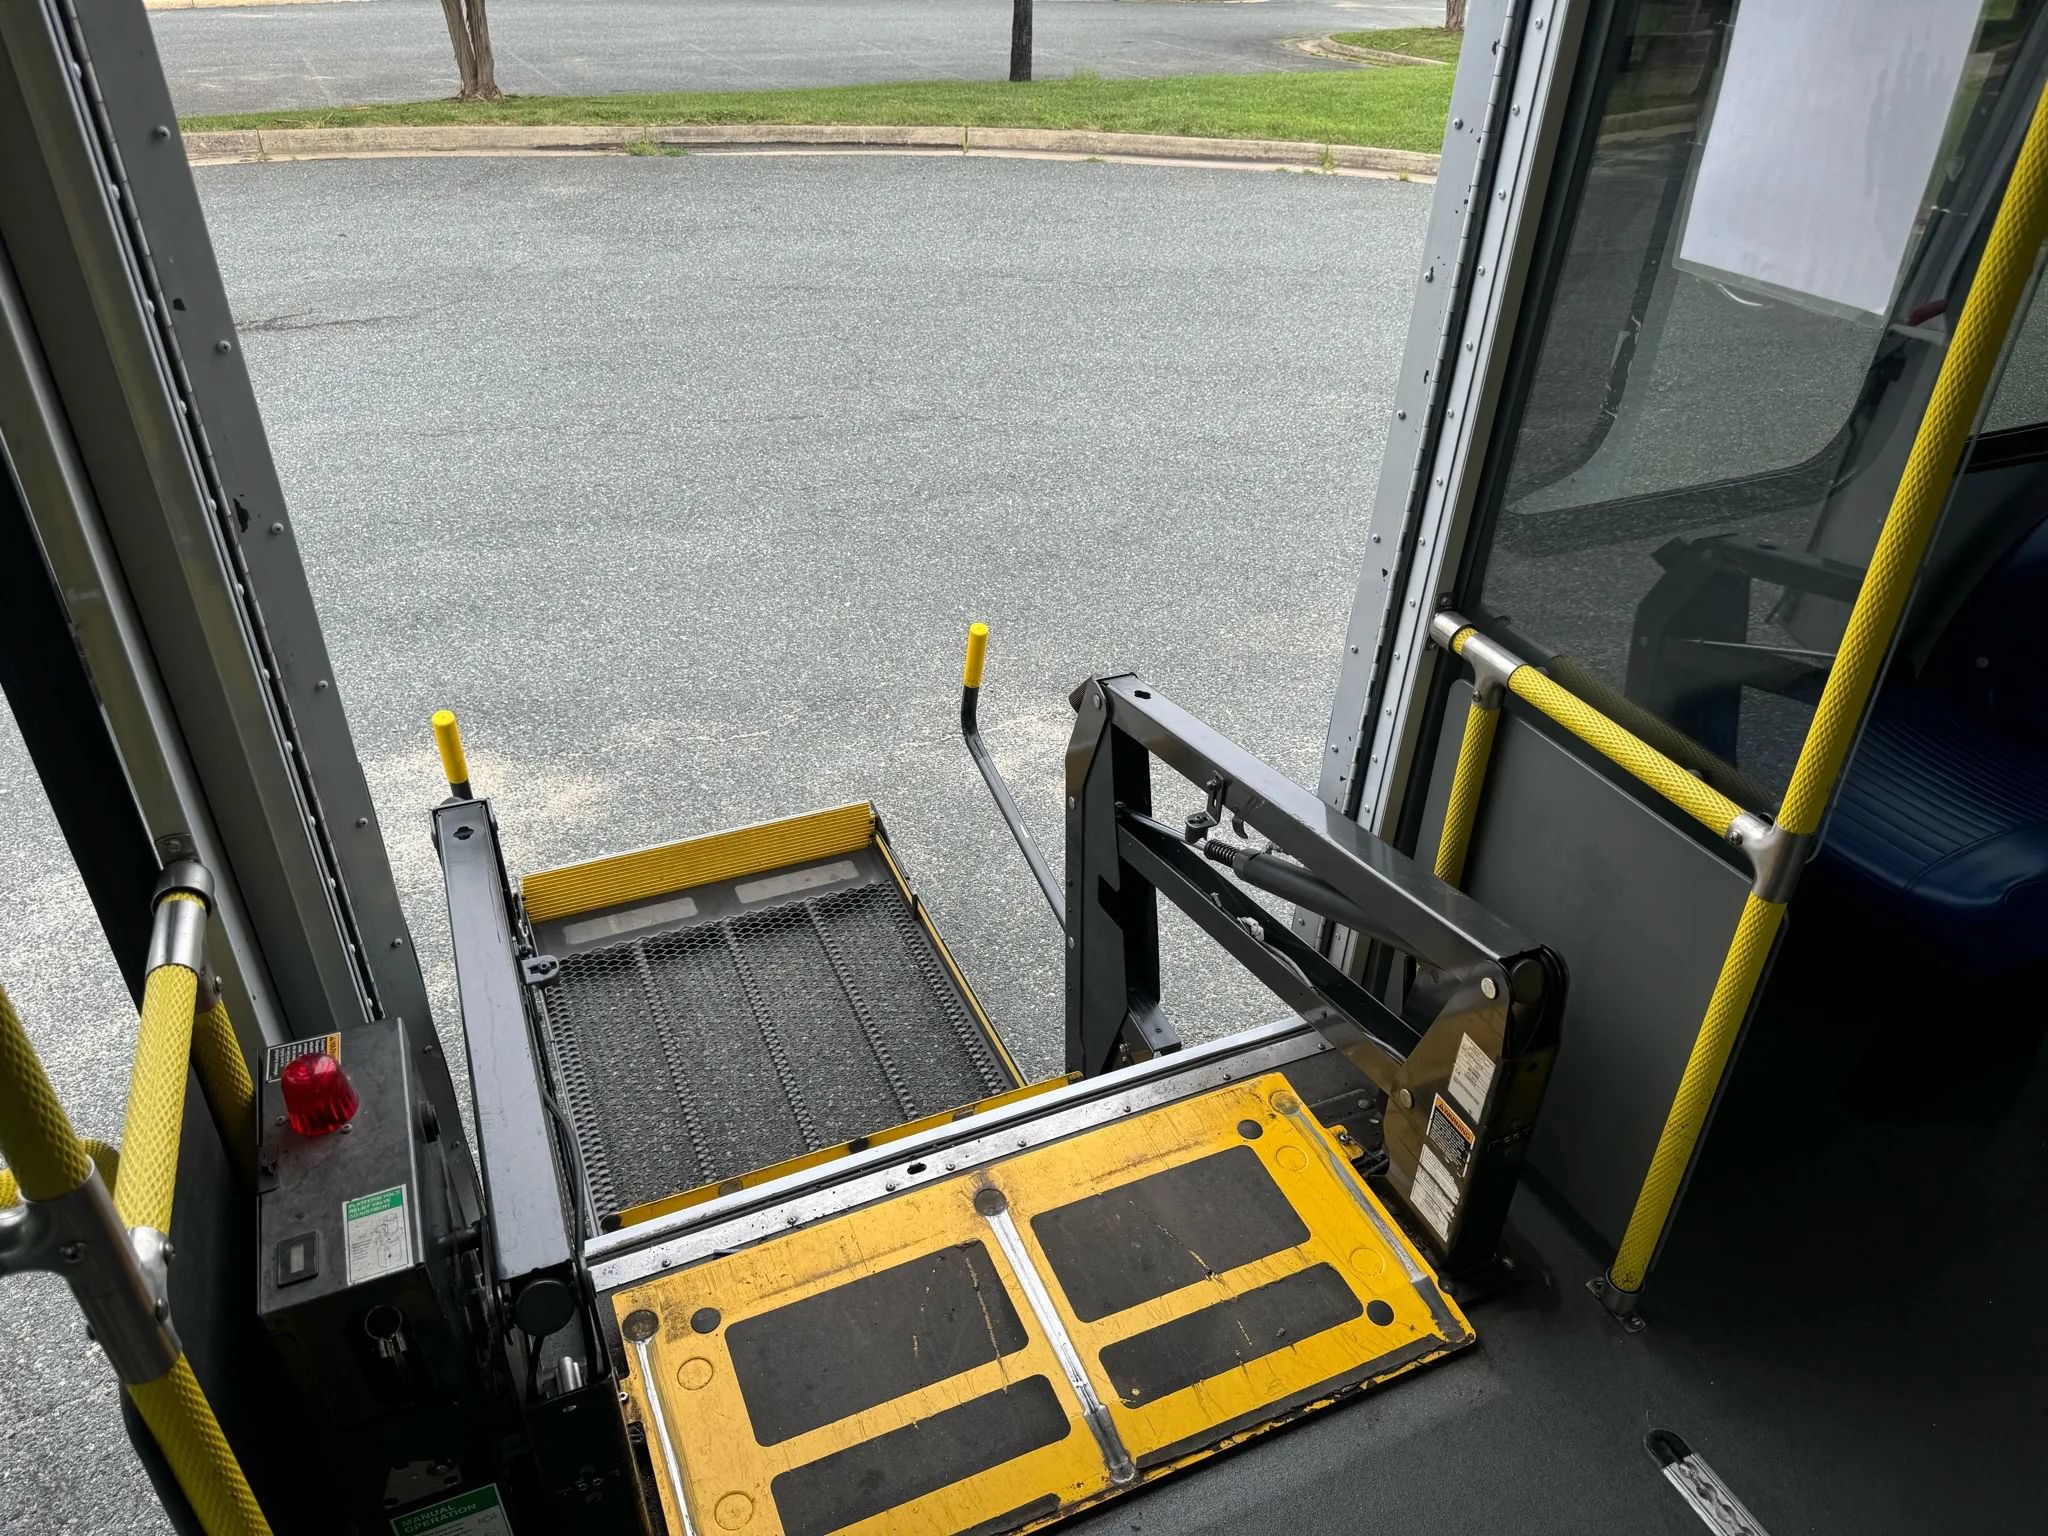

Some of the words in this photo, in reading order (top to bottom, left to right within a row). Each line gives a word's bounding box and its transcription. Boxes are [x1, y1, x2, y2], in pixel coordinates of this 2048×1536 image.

[1444, 1107, 1471, 1140] WARNING
[349, 1204, 370, 1213] RELIEF
[349, 1203, 391, 1217] ADJUSTMENT
[401, 1504, 455, 1527] MANUAL
[404, 1503, 477, 1533] OPERATION
